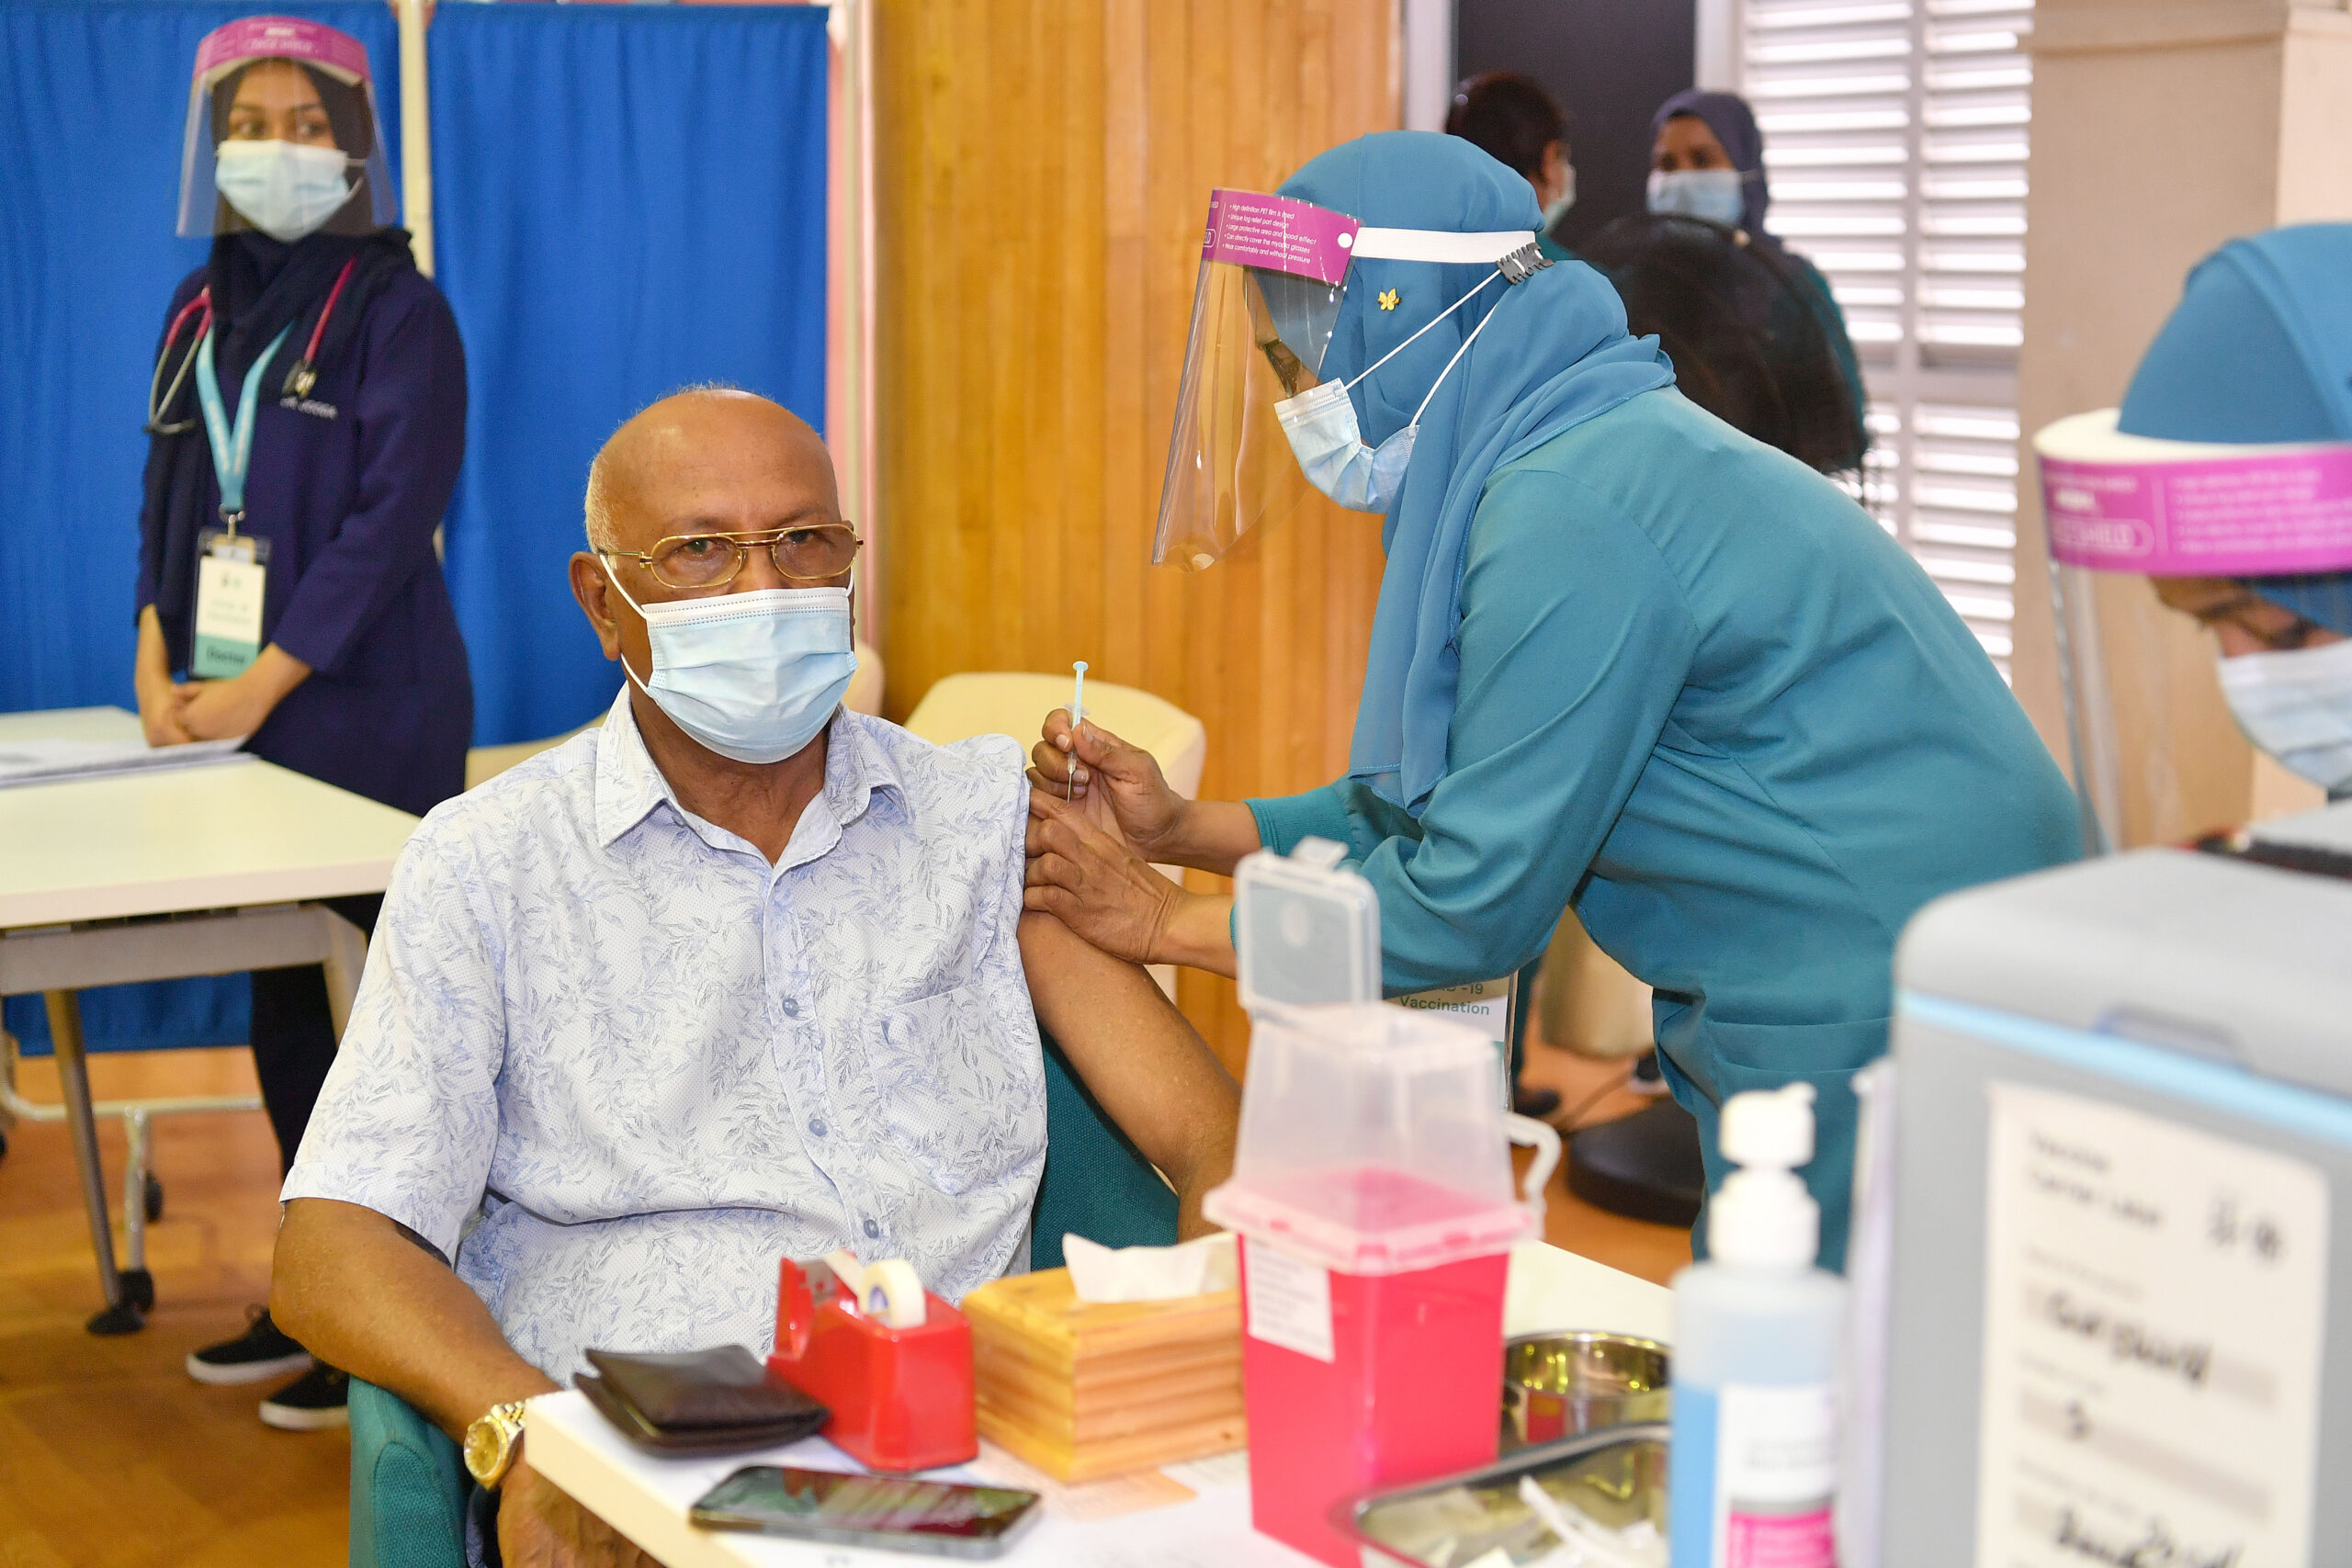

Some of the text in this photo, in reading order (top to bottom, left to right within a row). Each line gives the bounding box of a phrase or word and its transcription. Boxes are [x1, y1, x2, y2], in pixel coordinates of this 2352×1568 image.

[1238, 225, 1260, 233] protective
[1299, 235, 1316, 244] effect
[1272, 220, 1289, 229] design
[1235, 233, 1249, 243] directly
[1291, 244, 1310, 254] glasses
[1234, 244, 1259, 254] comfortably
[1270, 249, 1287, 258] without
[1288, 254, 1310, 264] pressure
[1399, 995, 1490, 1016] Vaccination
